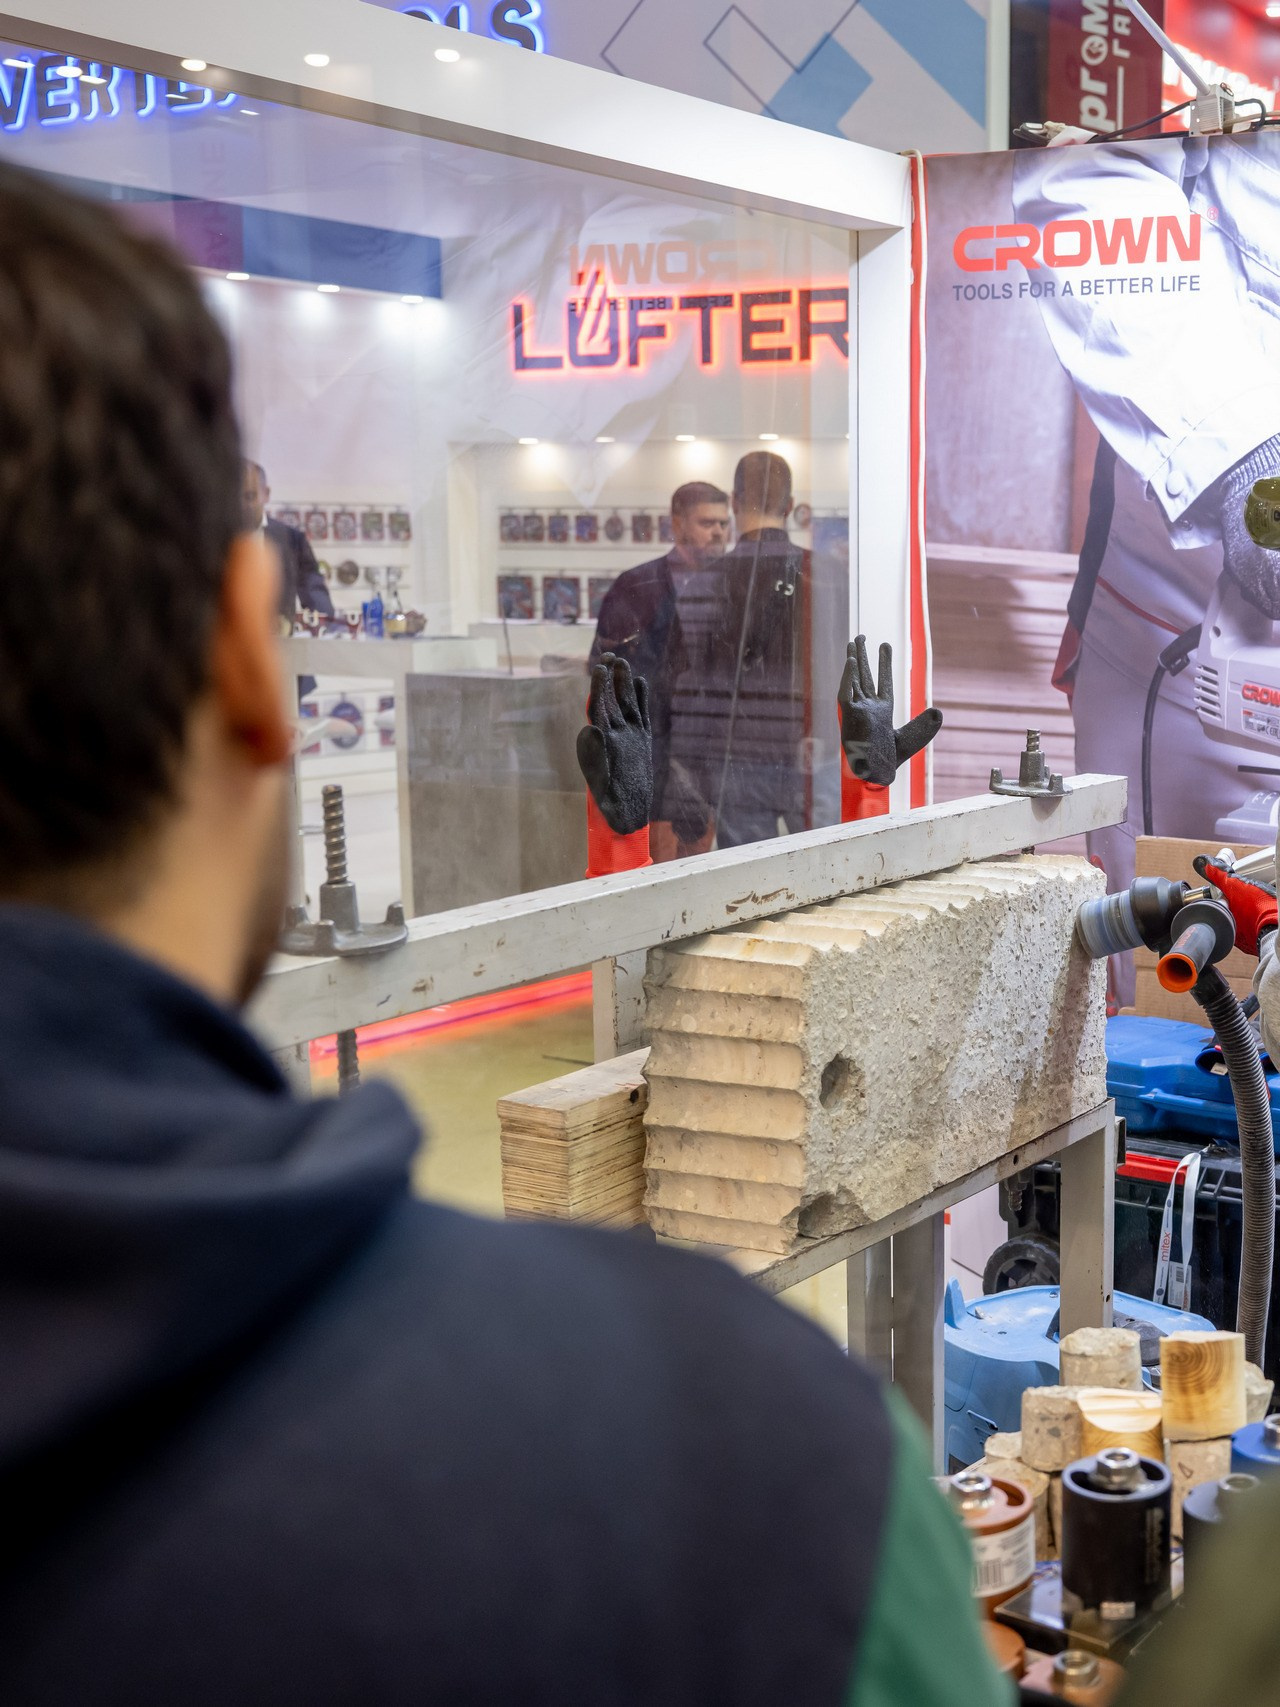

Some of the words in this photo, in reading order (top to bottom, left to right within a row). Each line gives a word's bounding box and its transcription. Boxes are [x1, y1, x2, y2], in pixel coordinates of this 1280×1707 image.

[953, 214, 1201, 272] CROWN
[953, 283, 1012, 301] TOOLS
[1019, 281, 1055, 298] FOR
[1062, 281, 1074, 296] A
[1080, 277, 1153, 295] BETTER
[1161, 275, 1200, 292] LIFE
[1161, 1231, 1171, 1262] mitex
